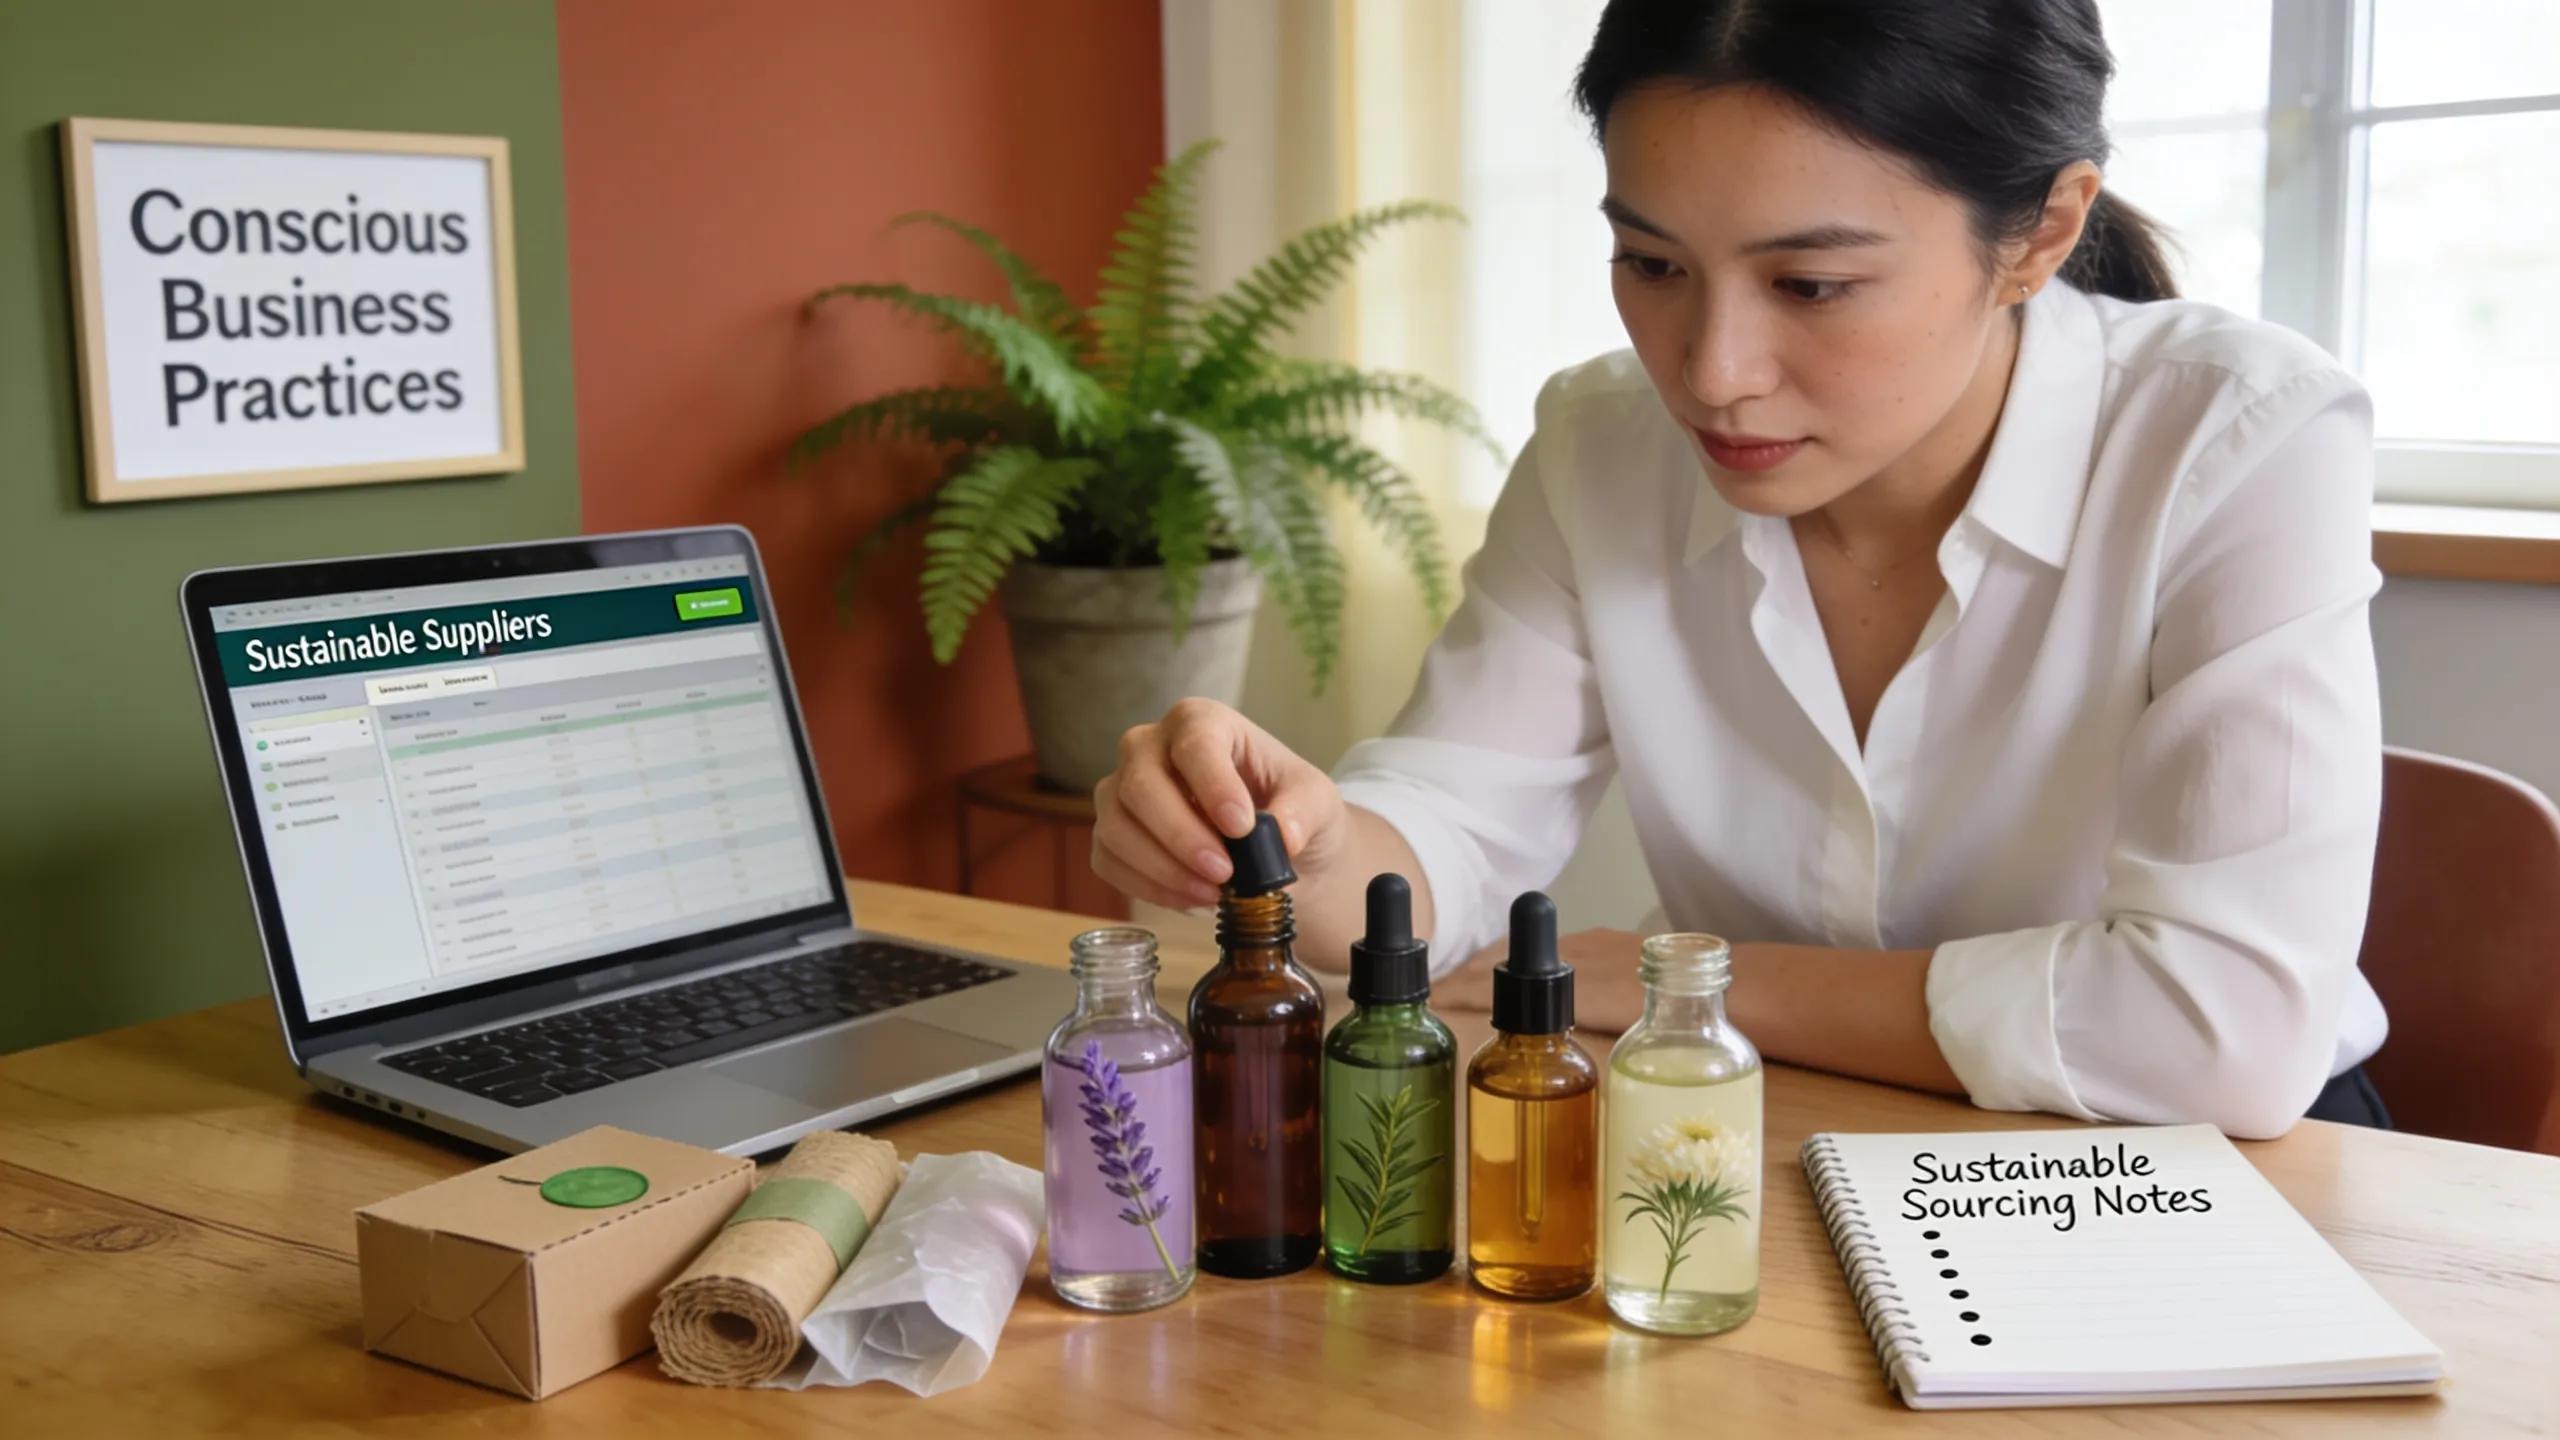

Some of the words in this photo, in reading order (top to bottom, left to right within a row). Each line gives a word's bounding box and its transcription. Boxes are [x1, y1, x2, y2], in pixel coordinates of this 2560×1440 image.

[129, 187, 469, 256] Conscious
[160, 276, 452, 342] Business
[161, 356, 464, 428] Practices
[244, 620, 418, 673] Sustainable
[422, 609, 553, 657] Suppliers
[1911, 1142, 2156, 1185] Sustainable
[1901, 1188, 2077, 1232] Sourcing
[2093, 1184, 2213, 1217] Notes
